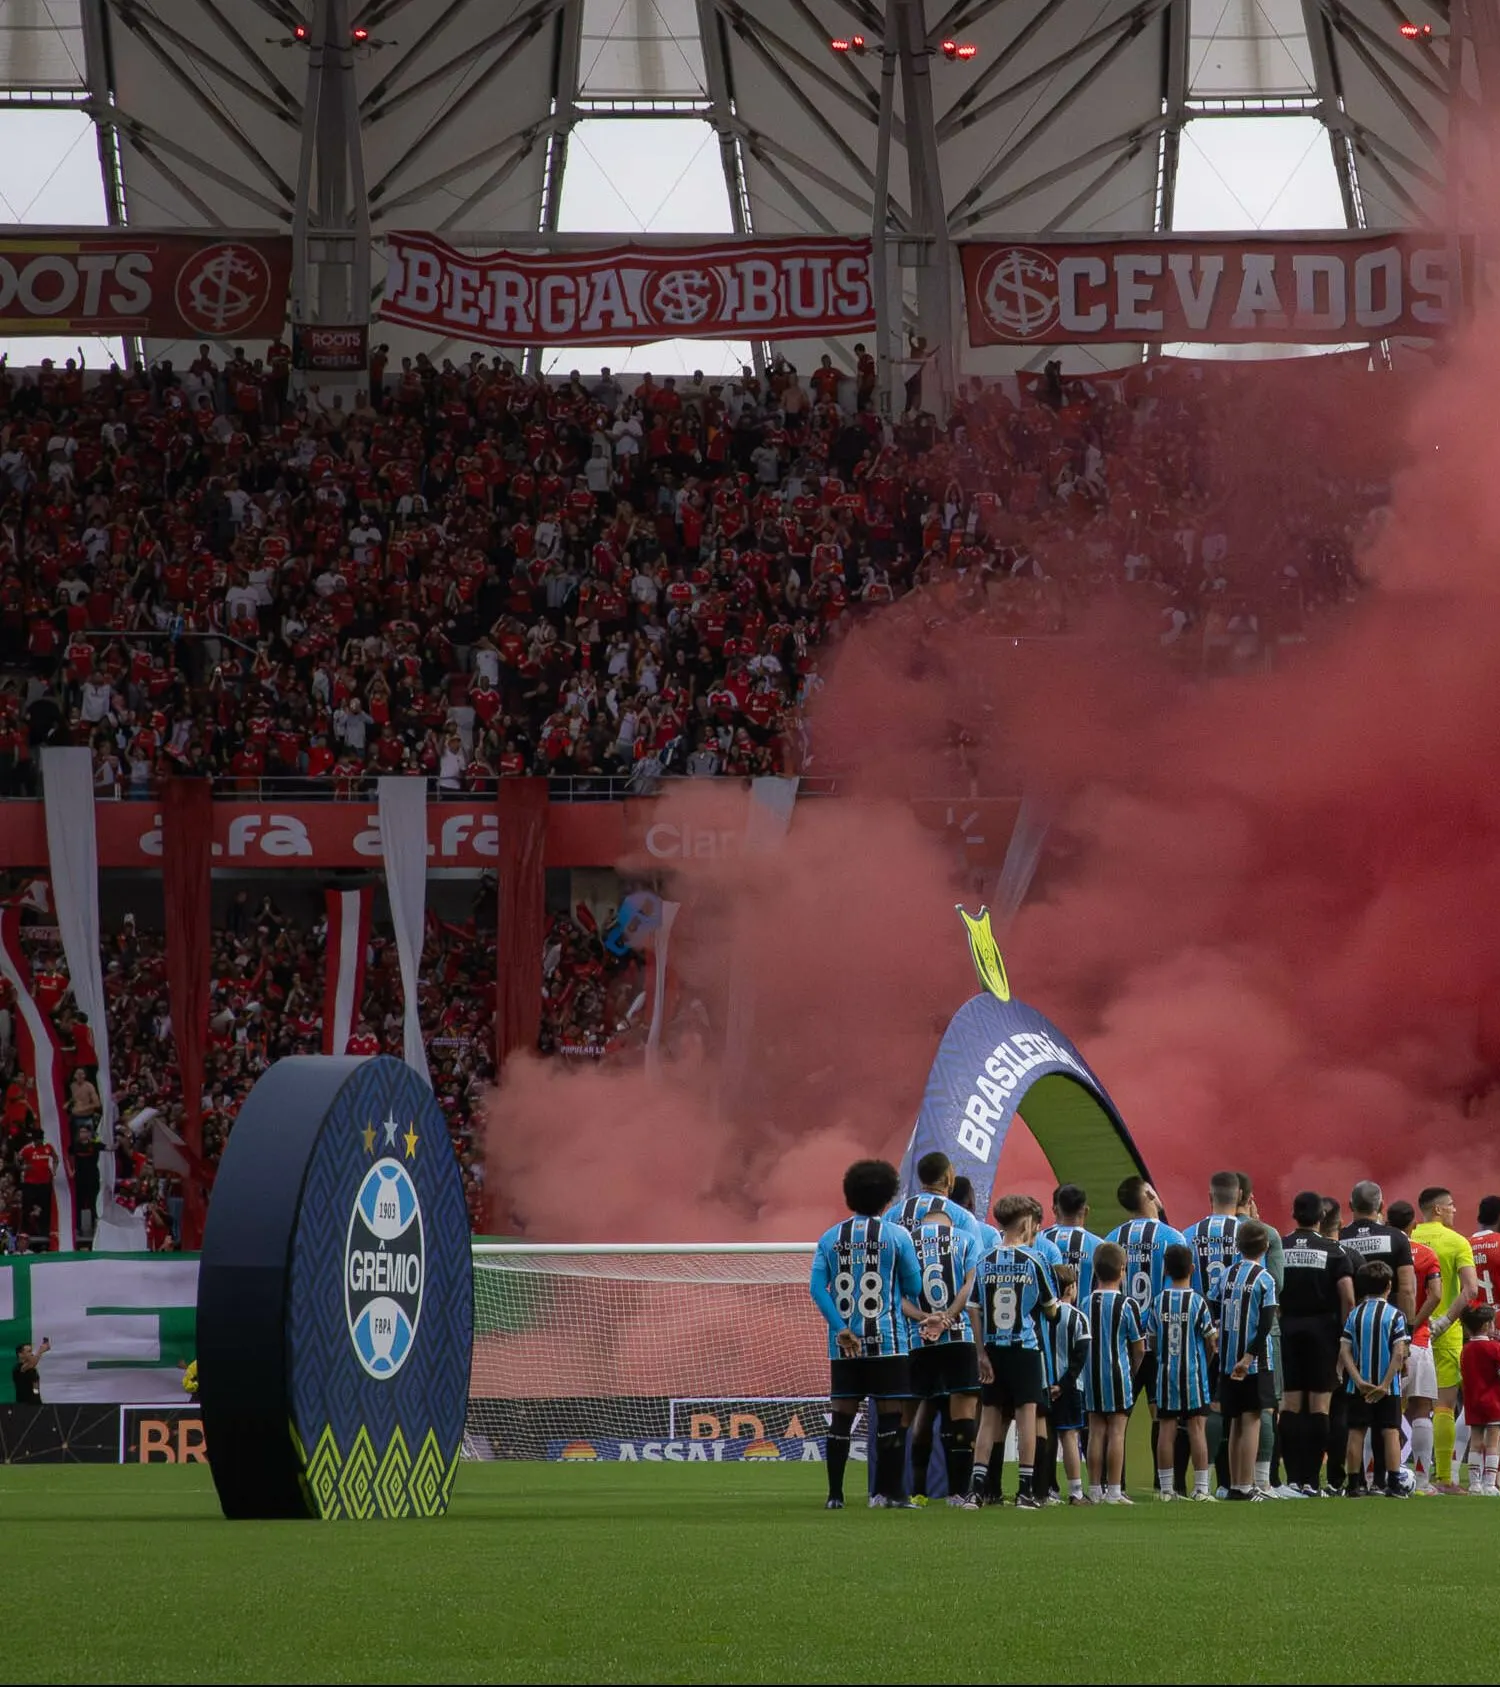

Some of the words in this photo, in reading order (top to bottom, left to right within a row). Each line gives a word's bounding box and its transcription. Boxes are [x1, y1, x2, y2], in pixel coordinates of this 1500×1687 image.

[402, 246, 634, 333] BERGA
[732, 258, 868, 322] BUS
[1057, 247, 1460, 331] CEVADOS
[312, 332, 361, 348] ROOTS
[379, 1202, 396, 1219] 1903
[350, 1240, 420, 1295] GRÊMIO
[923, 1264, 948, 1308] 6
[985, 1262, 1028, 1274] Banrisul
[835, 1271, 883, 1319] 88
[993, 1288, 1017, 1329] 8
[375, 1318, 391, 1335] FBPA
